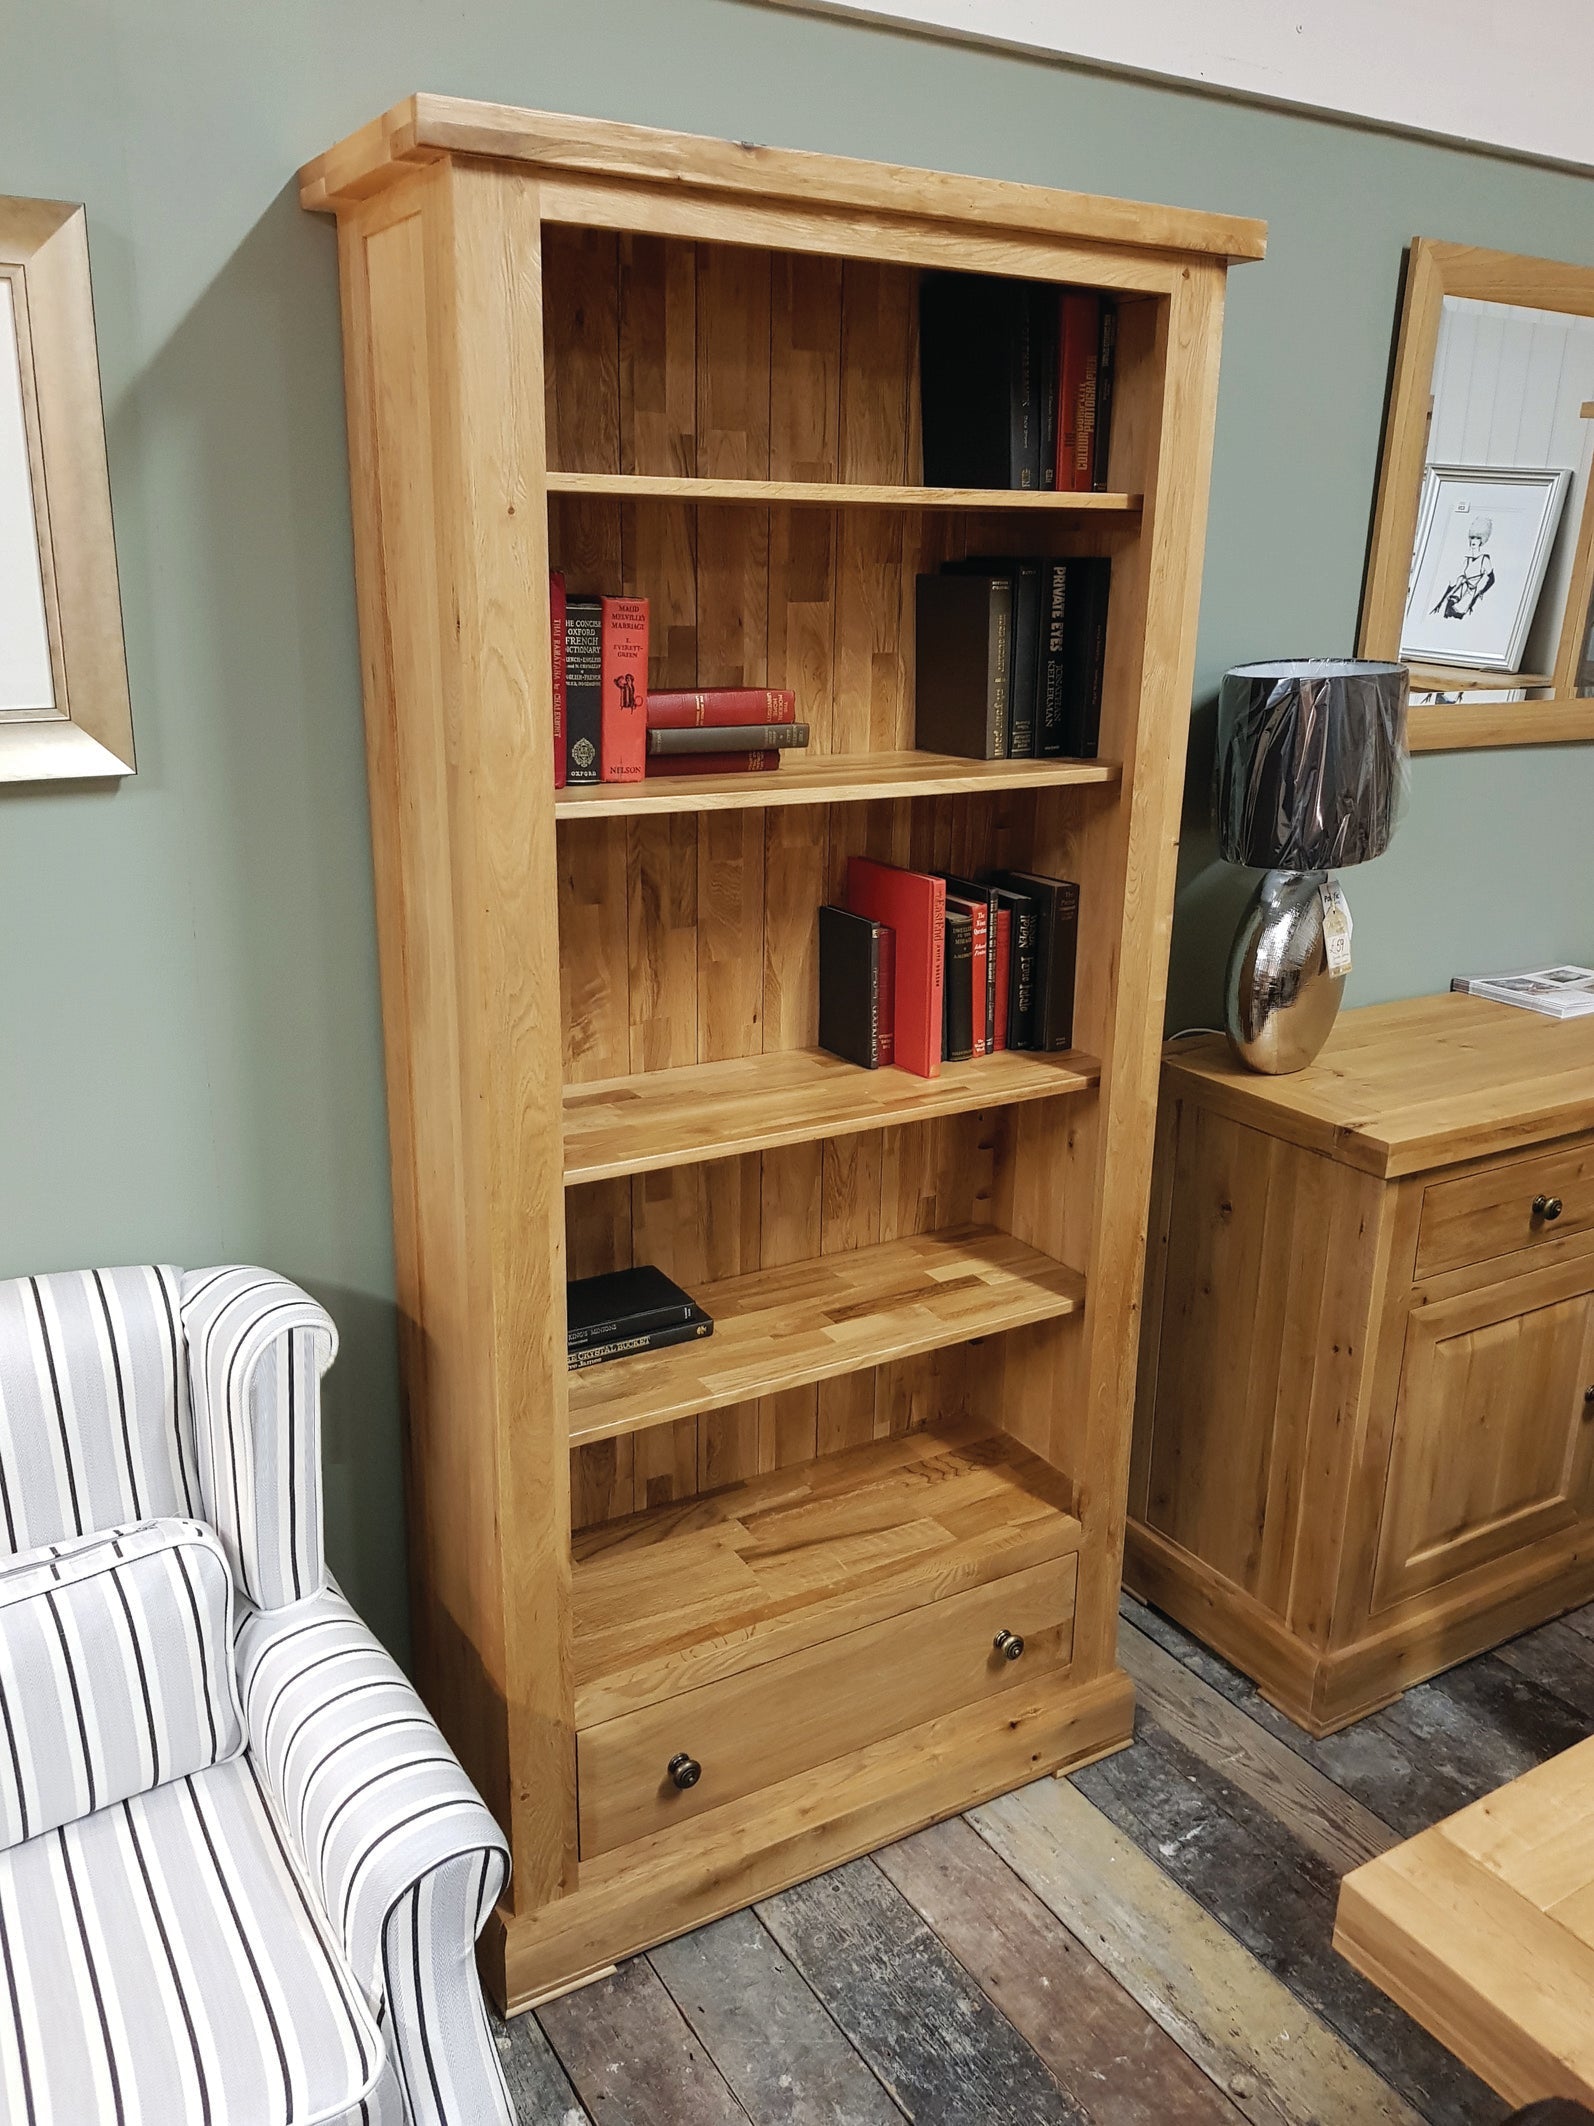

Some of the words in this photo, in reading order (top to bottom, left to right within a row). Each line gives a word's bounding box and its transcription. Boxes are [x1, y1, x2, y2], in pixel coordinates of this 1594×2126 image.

[1084, 355, 1098, 433] PHOTOGRAPHER
[1076, 431, 1090, 471] COLOUR
[1051, 566, 1067, 619] PRIVATE
[565, 619, 575, 628] HE
[575, 620, 602, 628] CONCISE
[567, 628, 596, 636] OXFORD
[611, 622, 645, 631] MARRIAGE
[1049, 622, 1065, 653] EYES
[565, 636, 599, 646] FRENCH
[1044, 659, 1056, 728] KELLERMAN
[1053, 663, 1065, 723] JONATHAN
[609, 766, 641, 775] NELSON
[577, 1343, 618, 1361] CRYSTAL
[617, 1335, 651, 1353] BUCKET
